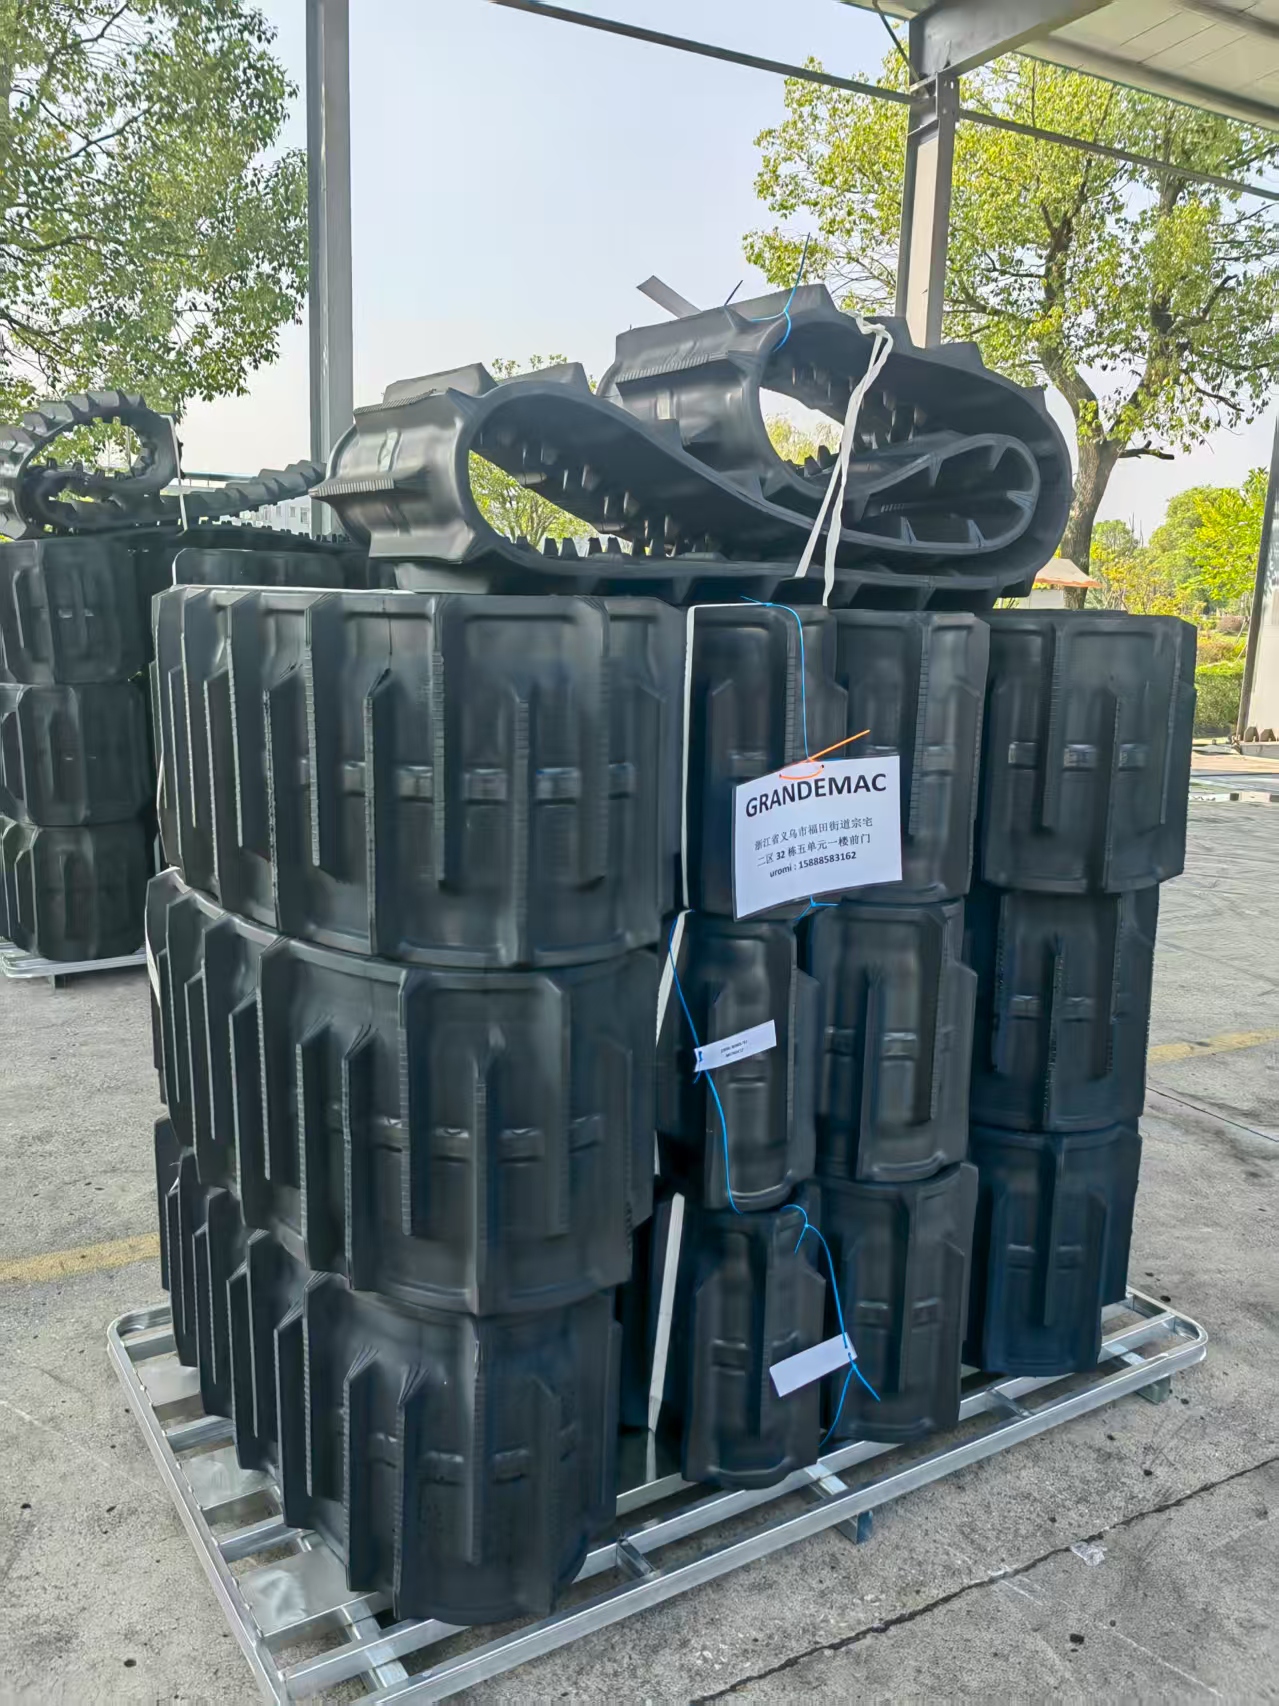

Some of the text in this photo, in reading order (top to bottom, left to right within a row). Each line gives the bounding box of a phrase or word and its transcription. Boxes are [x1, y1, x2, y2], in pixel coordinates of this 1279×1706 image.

[745, 773, 887, 818] GRANDEMAC
[754, 816, 873, 851] 浙江省义乌市福田街道宗宅
[776, 850, 786, 861] 32
[799, 851, 857, 869] 15888583162
